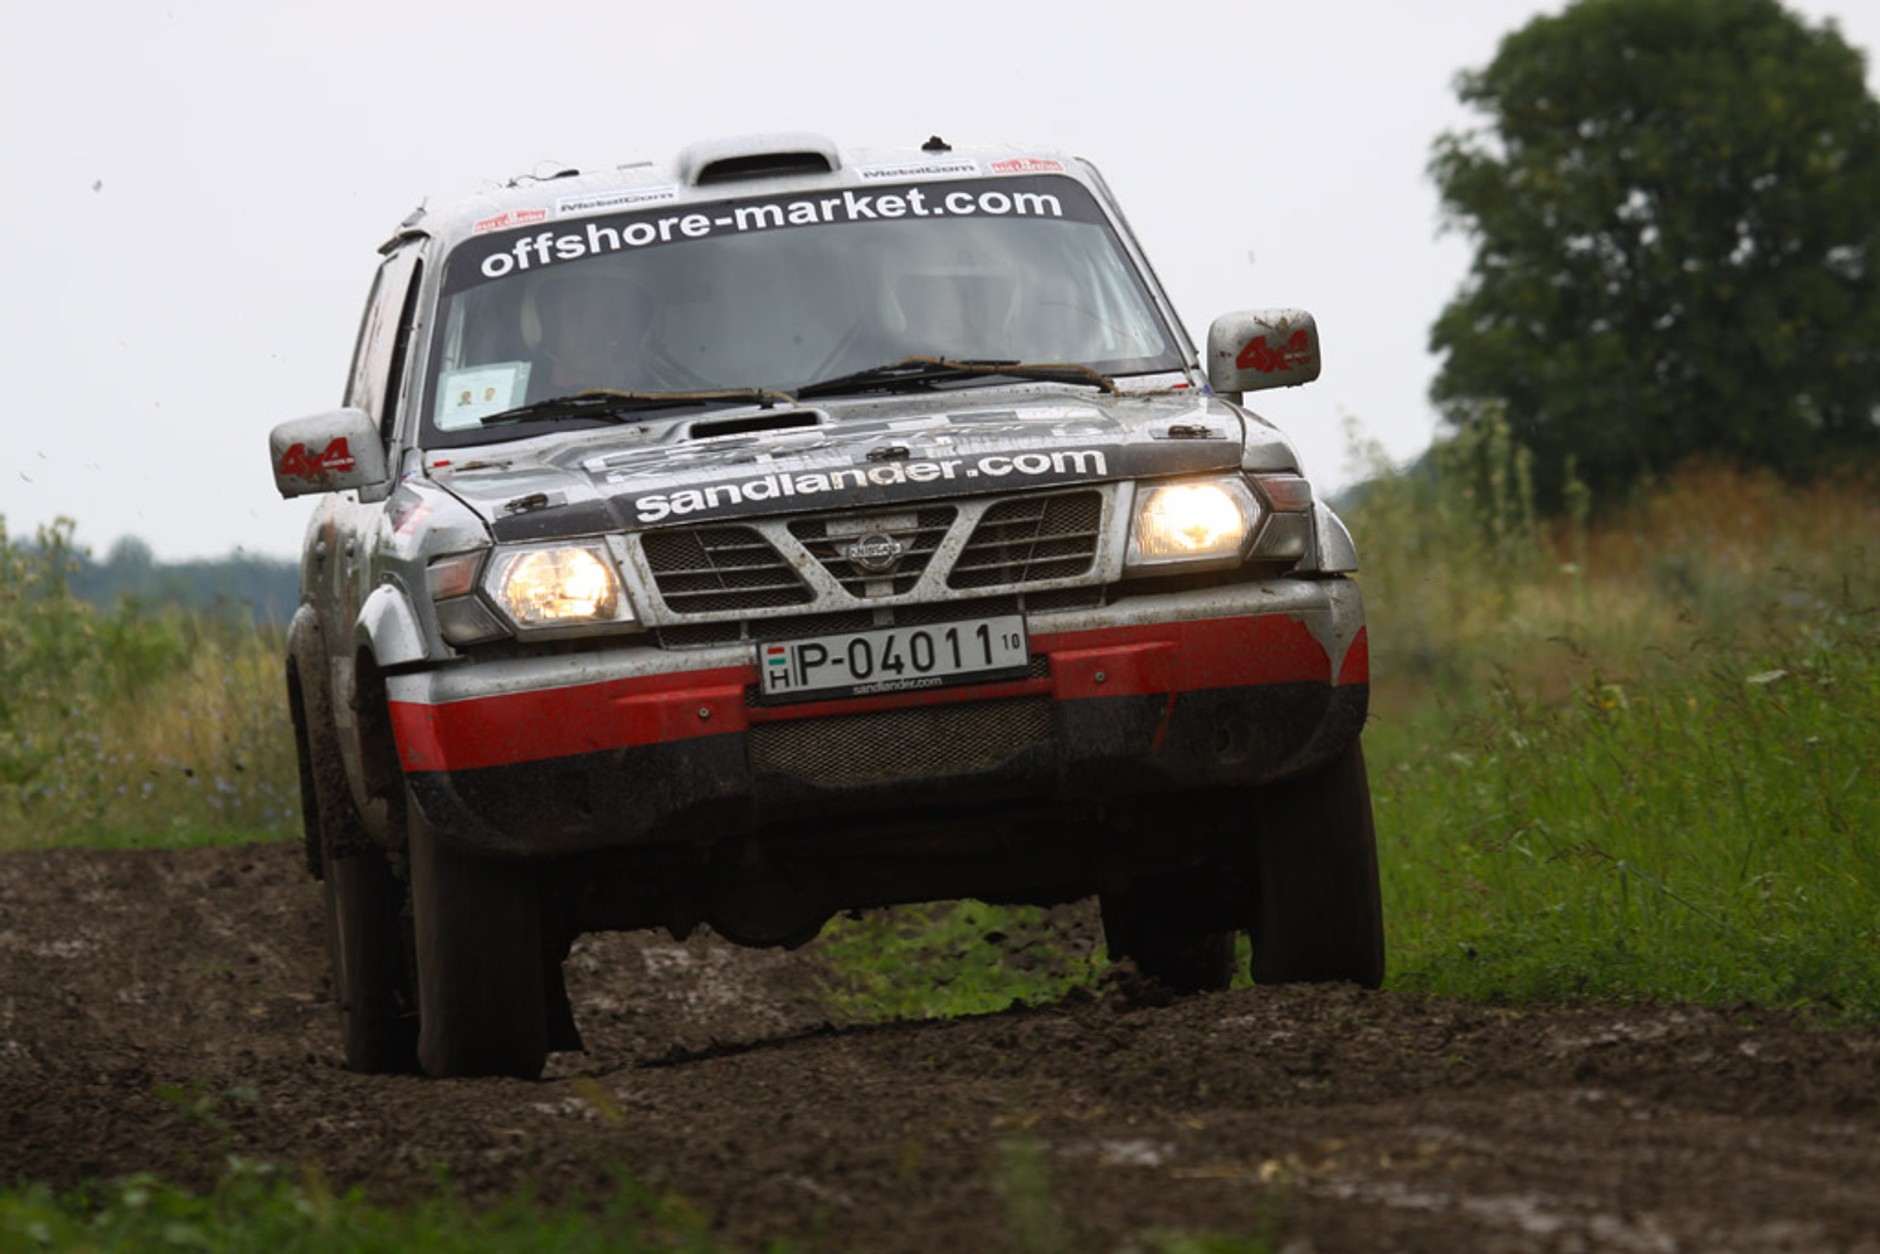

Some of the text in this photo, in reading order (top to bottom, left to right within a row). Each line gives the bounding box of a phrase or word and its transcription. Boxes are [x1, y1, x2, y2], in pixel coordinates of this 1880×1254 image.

[481, 188, 1062, 277] offshore-market.com
[635, 450, 1107, 522] sandlander.com
[769, 669, 790, 689] H
[797, 624, 1020, 685] P-04011 10
[853, 677, 942, 695] sandlander.com
